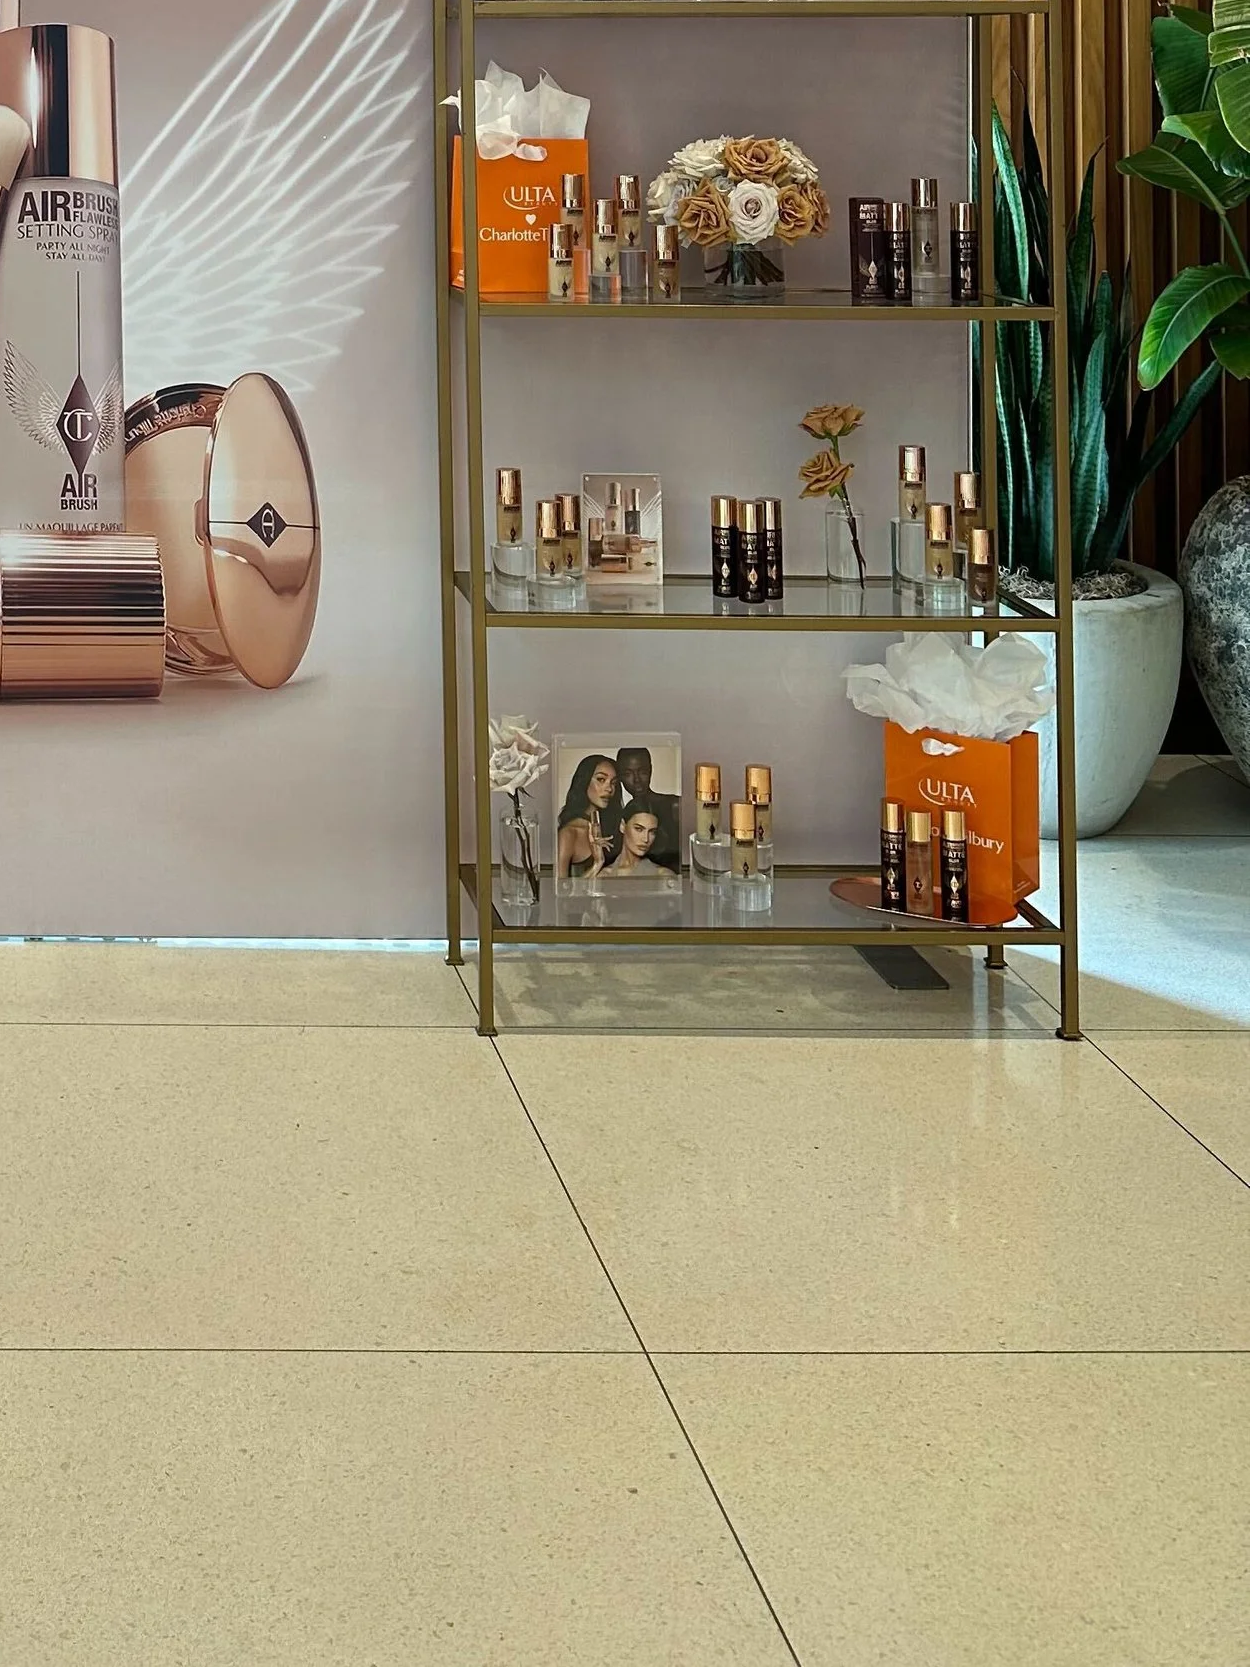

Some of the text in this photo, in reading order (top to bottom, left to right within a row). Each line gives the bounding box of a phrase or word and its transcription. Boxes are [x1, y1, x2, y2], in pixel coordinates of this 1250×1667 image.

[510, 185, 556, 202] ULTA
[73, 211, 119, 230] FLAWLESS
[17, 223, 84, 240] SETTING
[36, 241, 110, 255] PARTY ALL NIGHT
[45, 251, 68, 260] STAY
[71, 252, 85, 261] ALL
[60, 473, 98, 498] AIR
[60, 499, 98, 511] BRUSH
[926, 778, 975, 804] ULTA
